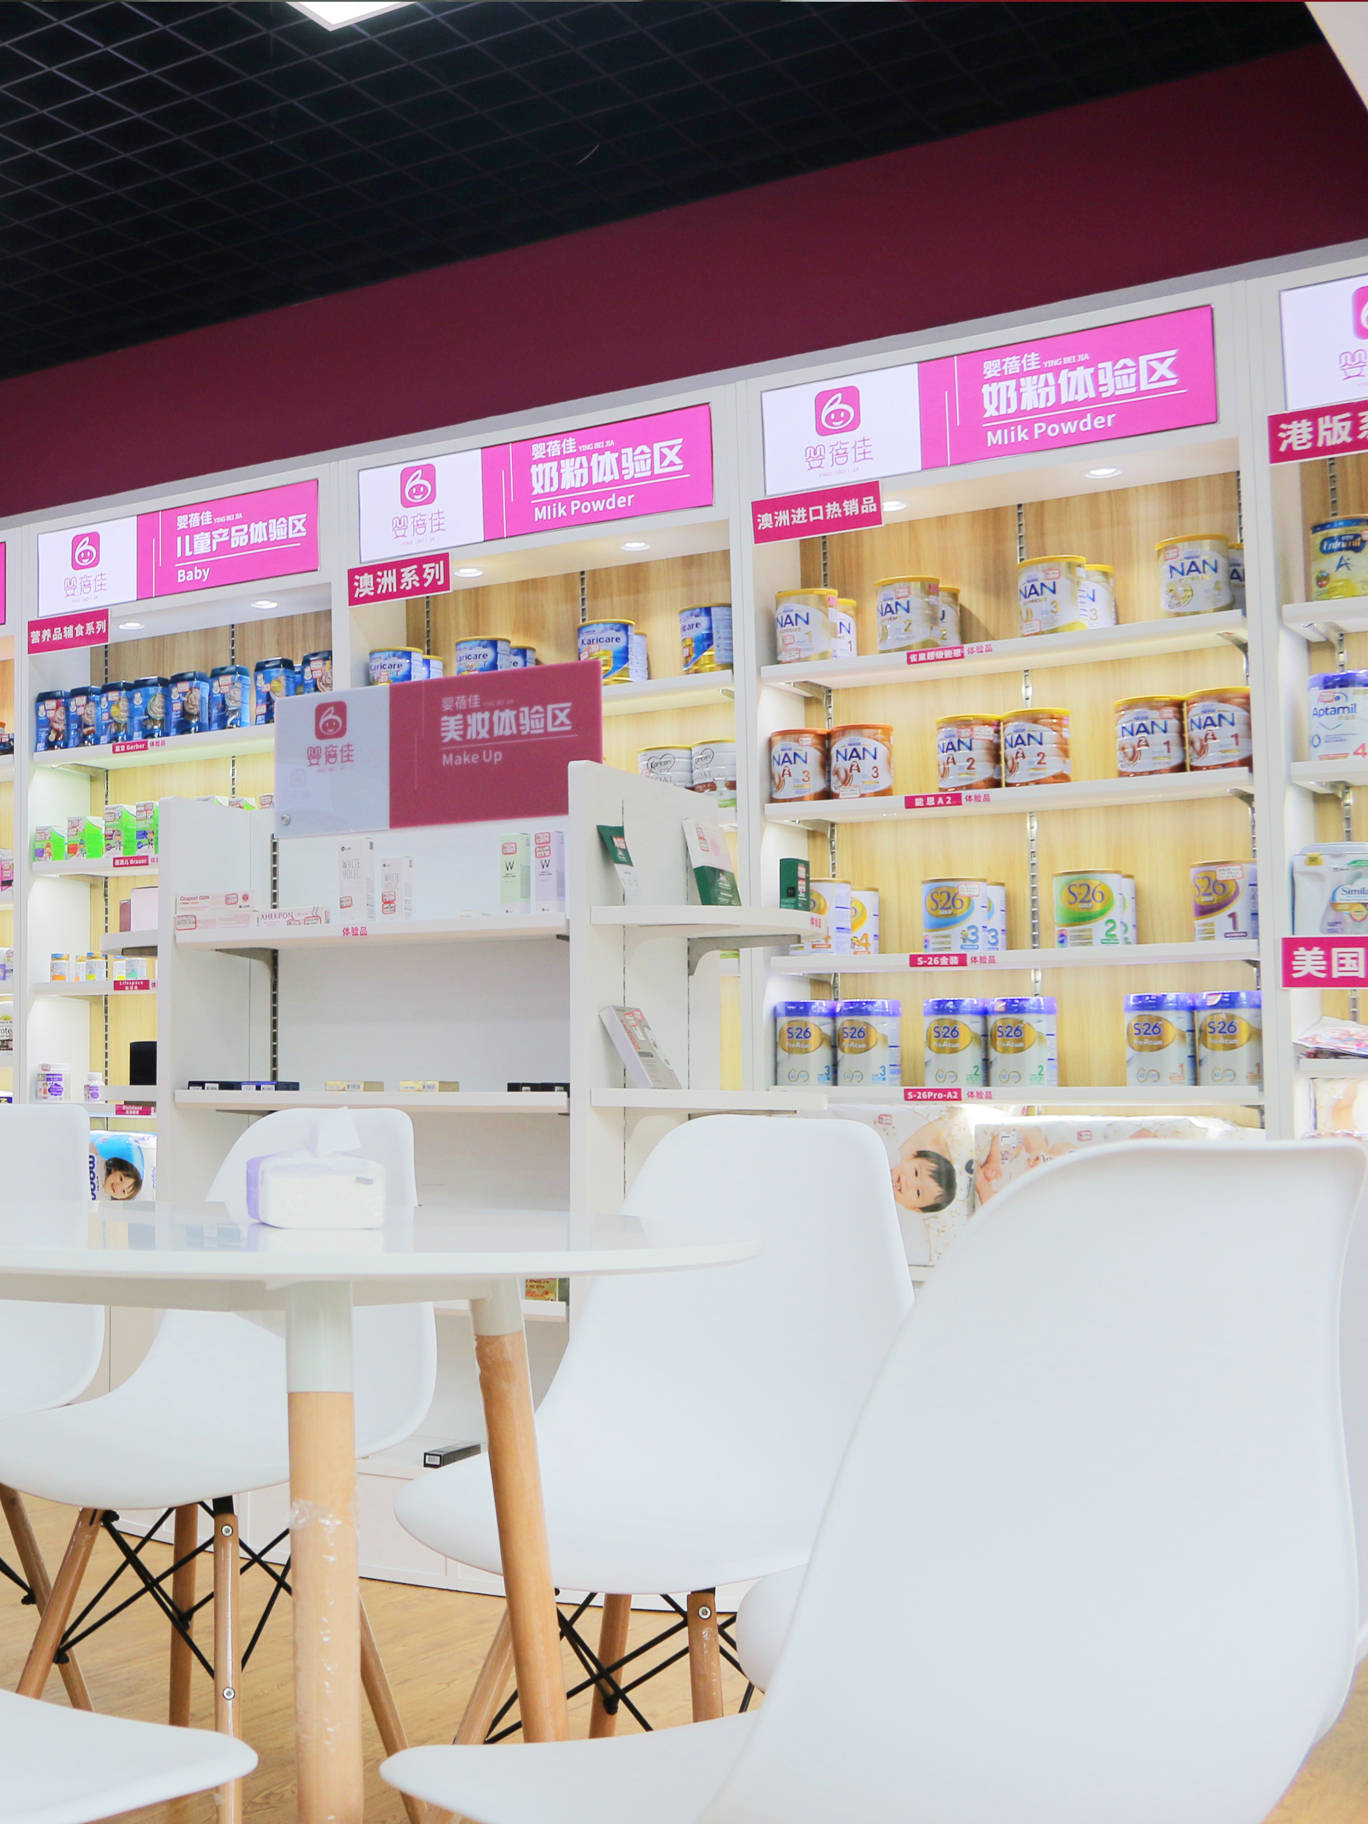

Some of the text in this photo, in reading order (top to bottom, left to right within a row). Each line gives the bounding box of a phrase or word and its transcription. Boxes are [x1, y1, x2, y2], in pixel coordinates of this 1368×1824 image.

[982, 349, 1179, 418] 奶粉体验区
[1034, 412, 1117, 440] Powder
[531, 438, 684, 495] 奶粉体验区
[570, 492, 635, 516] Powder
[756, 496, 877, 530] 澳洲进口热销品
[176, 513, 307, 558] 儿童产品体验区
[177, 567, 210, 583] Baby
[1169, 559, 1218, 578] NAN
[354, 561, 445, 599] 澳洲系列
[30, 620, 107, 644] 营养品辅食系列
[1313, 704, 1357, 718] Aptamil
[440, 702, 573, 743] 美妆体验区
[1121, 720, 1168, 736] NAN
[1189, 712, 1235, 730] NAN
[442, 750, 503, 766] Make Up
[772, 751, 808, 766] NAN
[835, 747, 877, 761] NAN
[1036, 751, 1046, 765] 2
[872, 766, 879, 779] 3
[966, 757, 975, 770] 2
[802, 770, 811, 783] 3
[1105, 918, 1117, 940] 2
